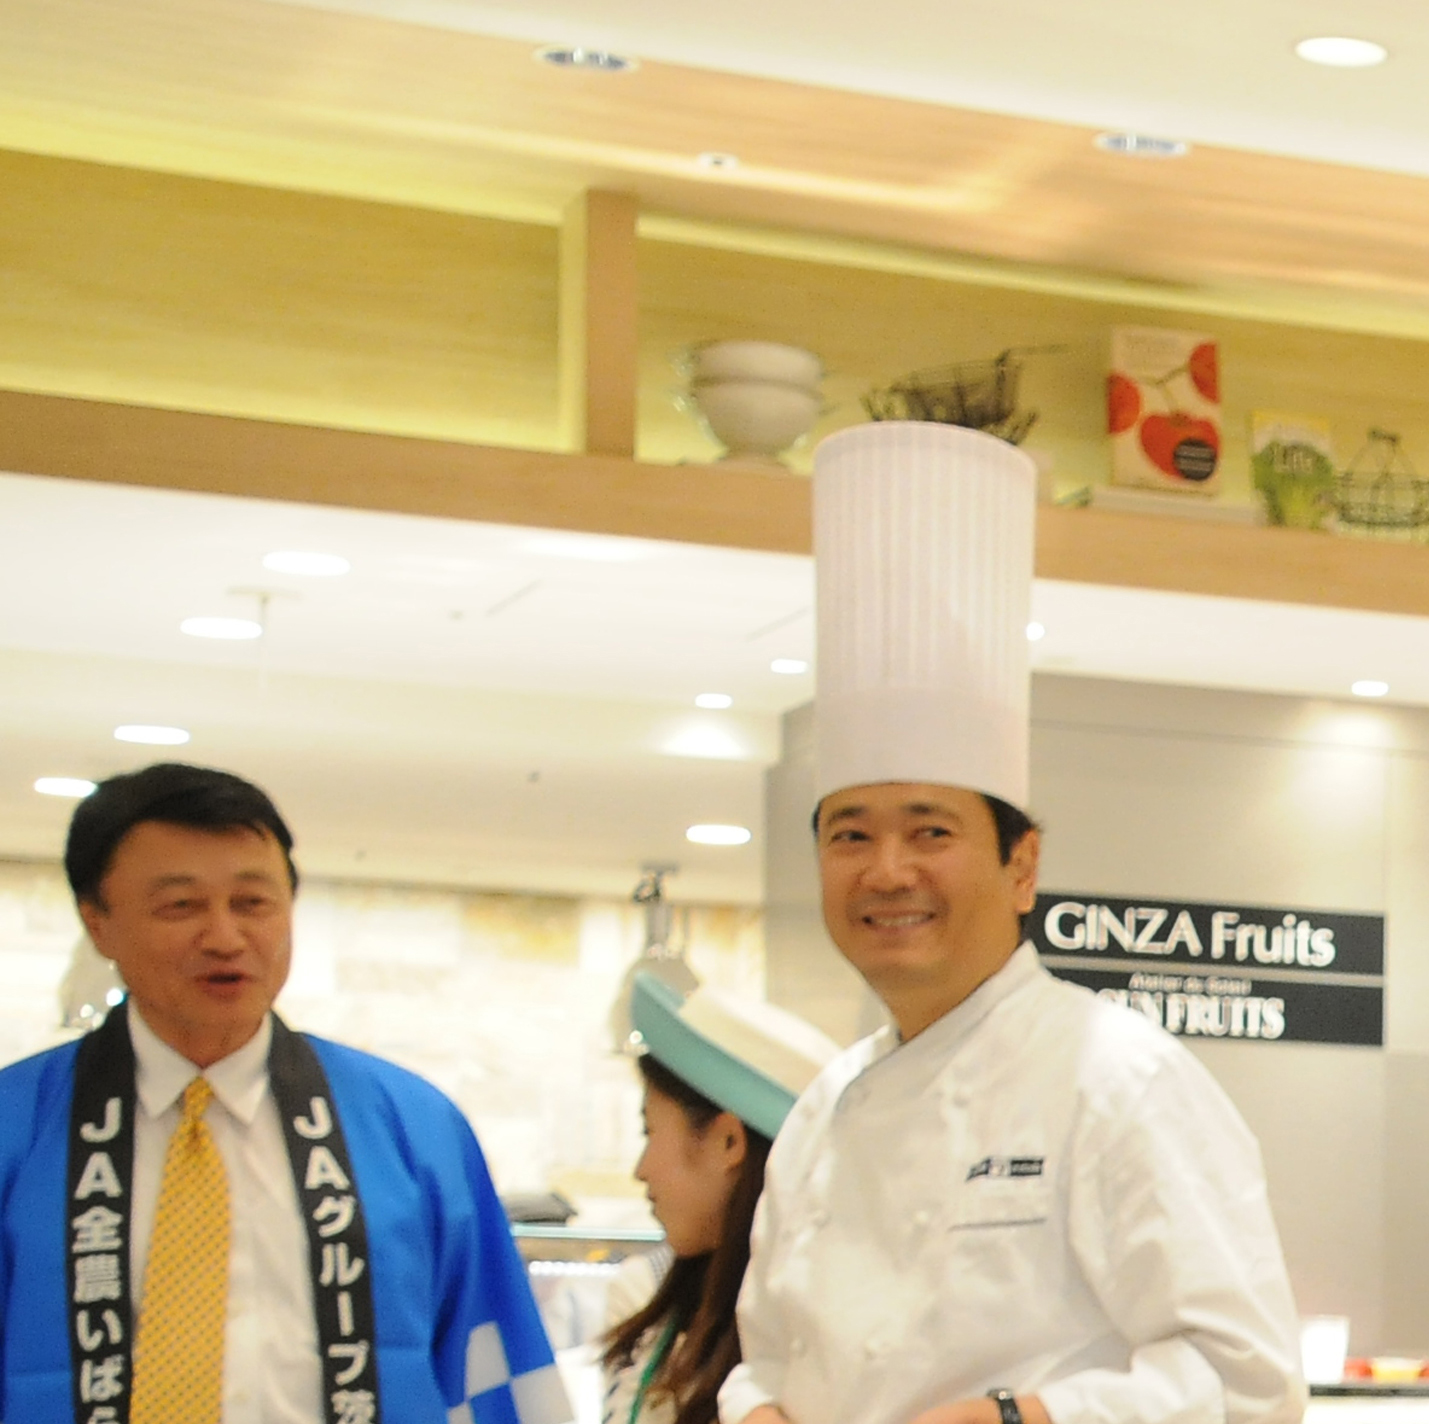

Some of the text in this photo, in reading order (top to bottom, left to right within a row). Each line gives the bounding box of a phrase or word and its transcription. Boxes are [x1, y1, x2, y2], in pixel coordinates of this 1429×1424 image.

[1044, 901, 1336, 967] GINZA Fruits
[1165, 992, 1286, 1039] FRUITS
